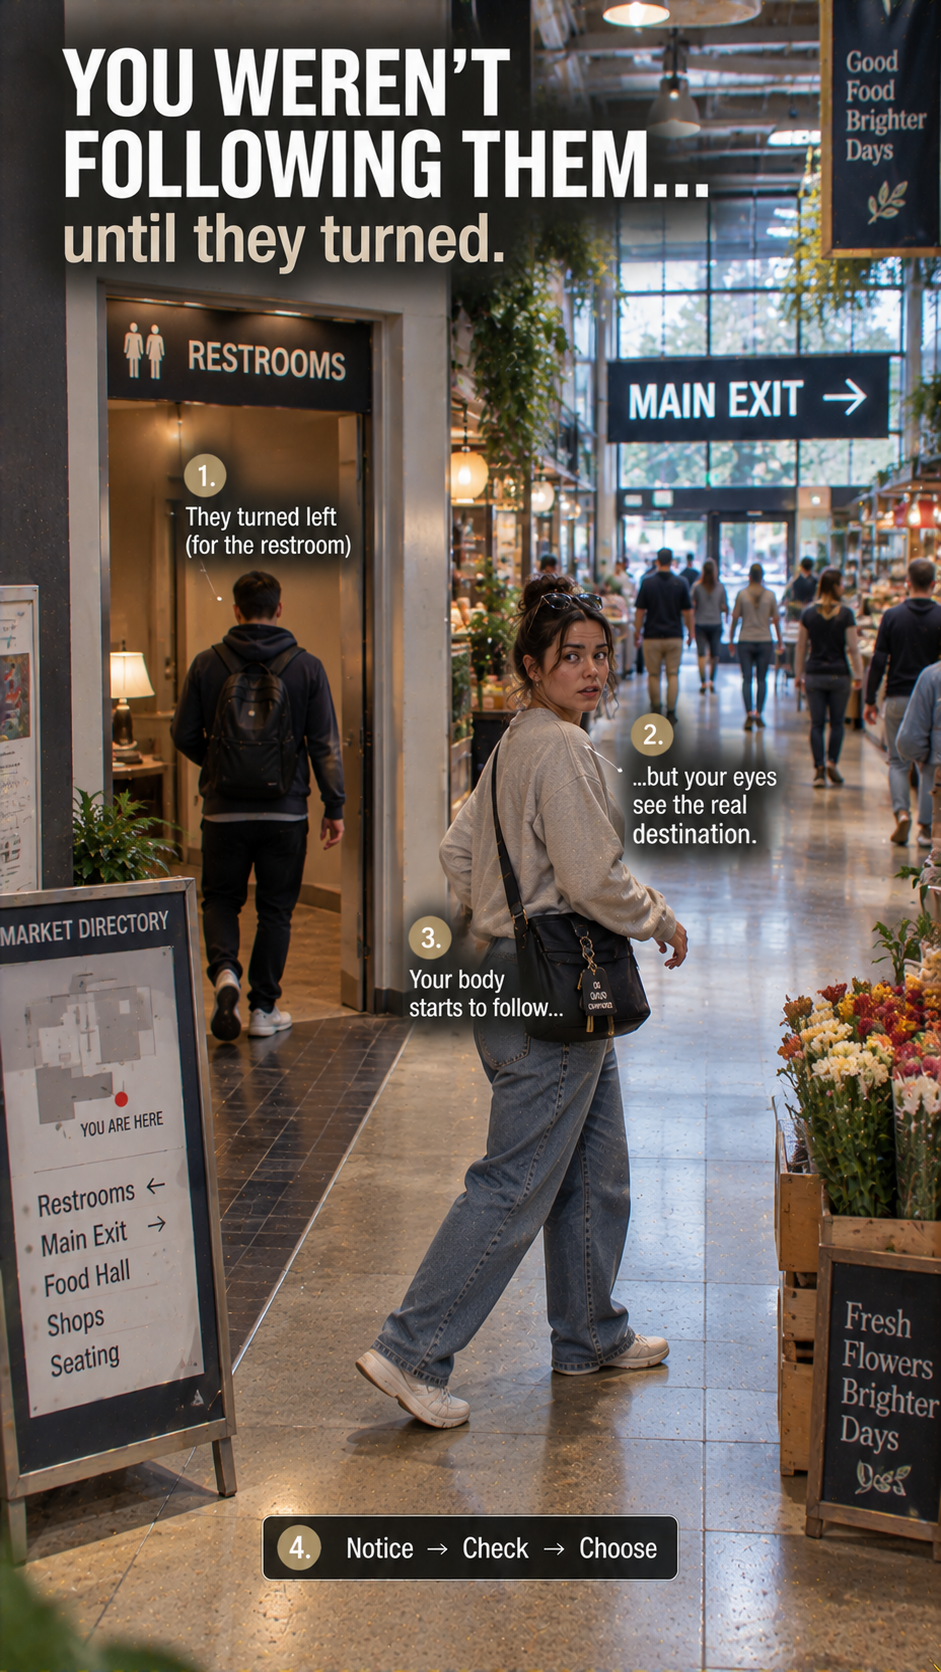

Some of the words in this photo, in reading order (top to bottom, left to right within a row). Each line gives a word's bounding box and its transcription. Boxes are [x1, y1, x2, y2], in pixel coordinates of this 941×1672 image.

[846, 49, 898, 73] Good
[846, 79, 895, 102] Food
[846, 107, 927, 136] Brighter
[846, 138, 894, 166] Days
[187, 338, 347, 382] RESTROOMS
[628, 381, 716, 421] MAIN
[728, 379, 805, 418] EXIT
[0, 920, 73, 947] MARKET
[78, 910, 169, 939] DIRECTORY
[80, 1120, 105, 1137] YOU
[108, 1116, 131, 1132] ARE
[134, 1111, 164, 1128] HERE
[37, 1184, 135, 1218] Restrooms
[41, 1229, 87, 1257] Main
[93, 1221, 128, 1247] Exit
[44, 1267, 90, 1297] Food
[95, 1258, 131, 1286] Hall
[47, 1309, 105, 1337] Shops
[845, 1301, 912, 1339] Fresh
[51, 1345, 120, 1378] Seating
[842, 1339, 933, 1380] Flowers
[841, 1377, 940, 1418] Brighter
[840, 1414, 899, 1454] Days
